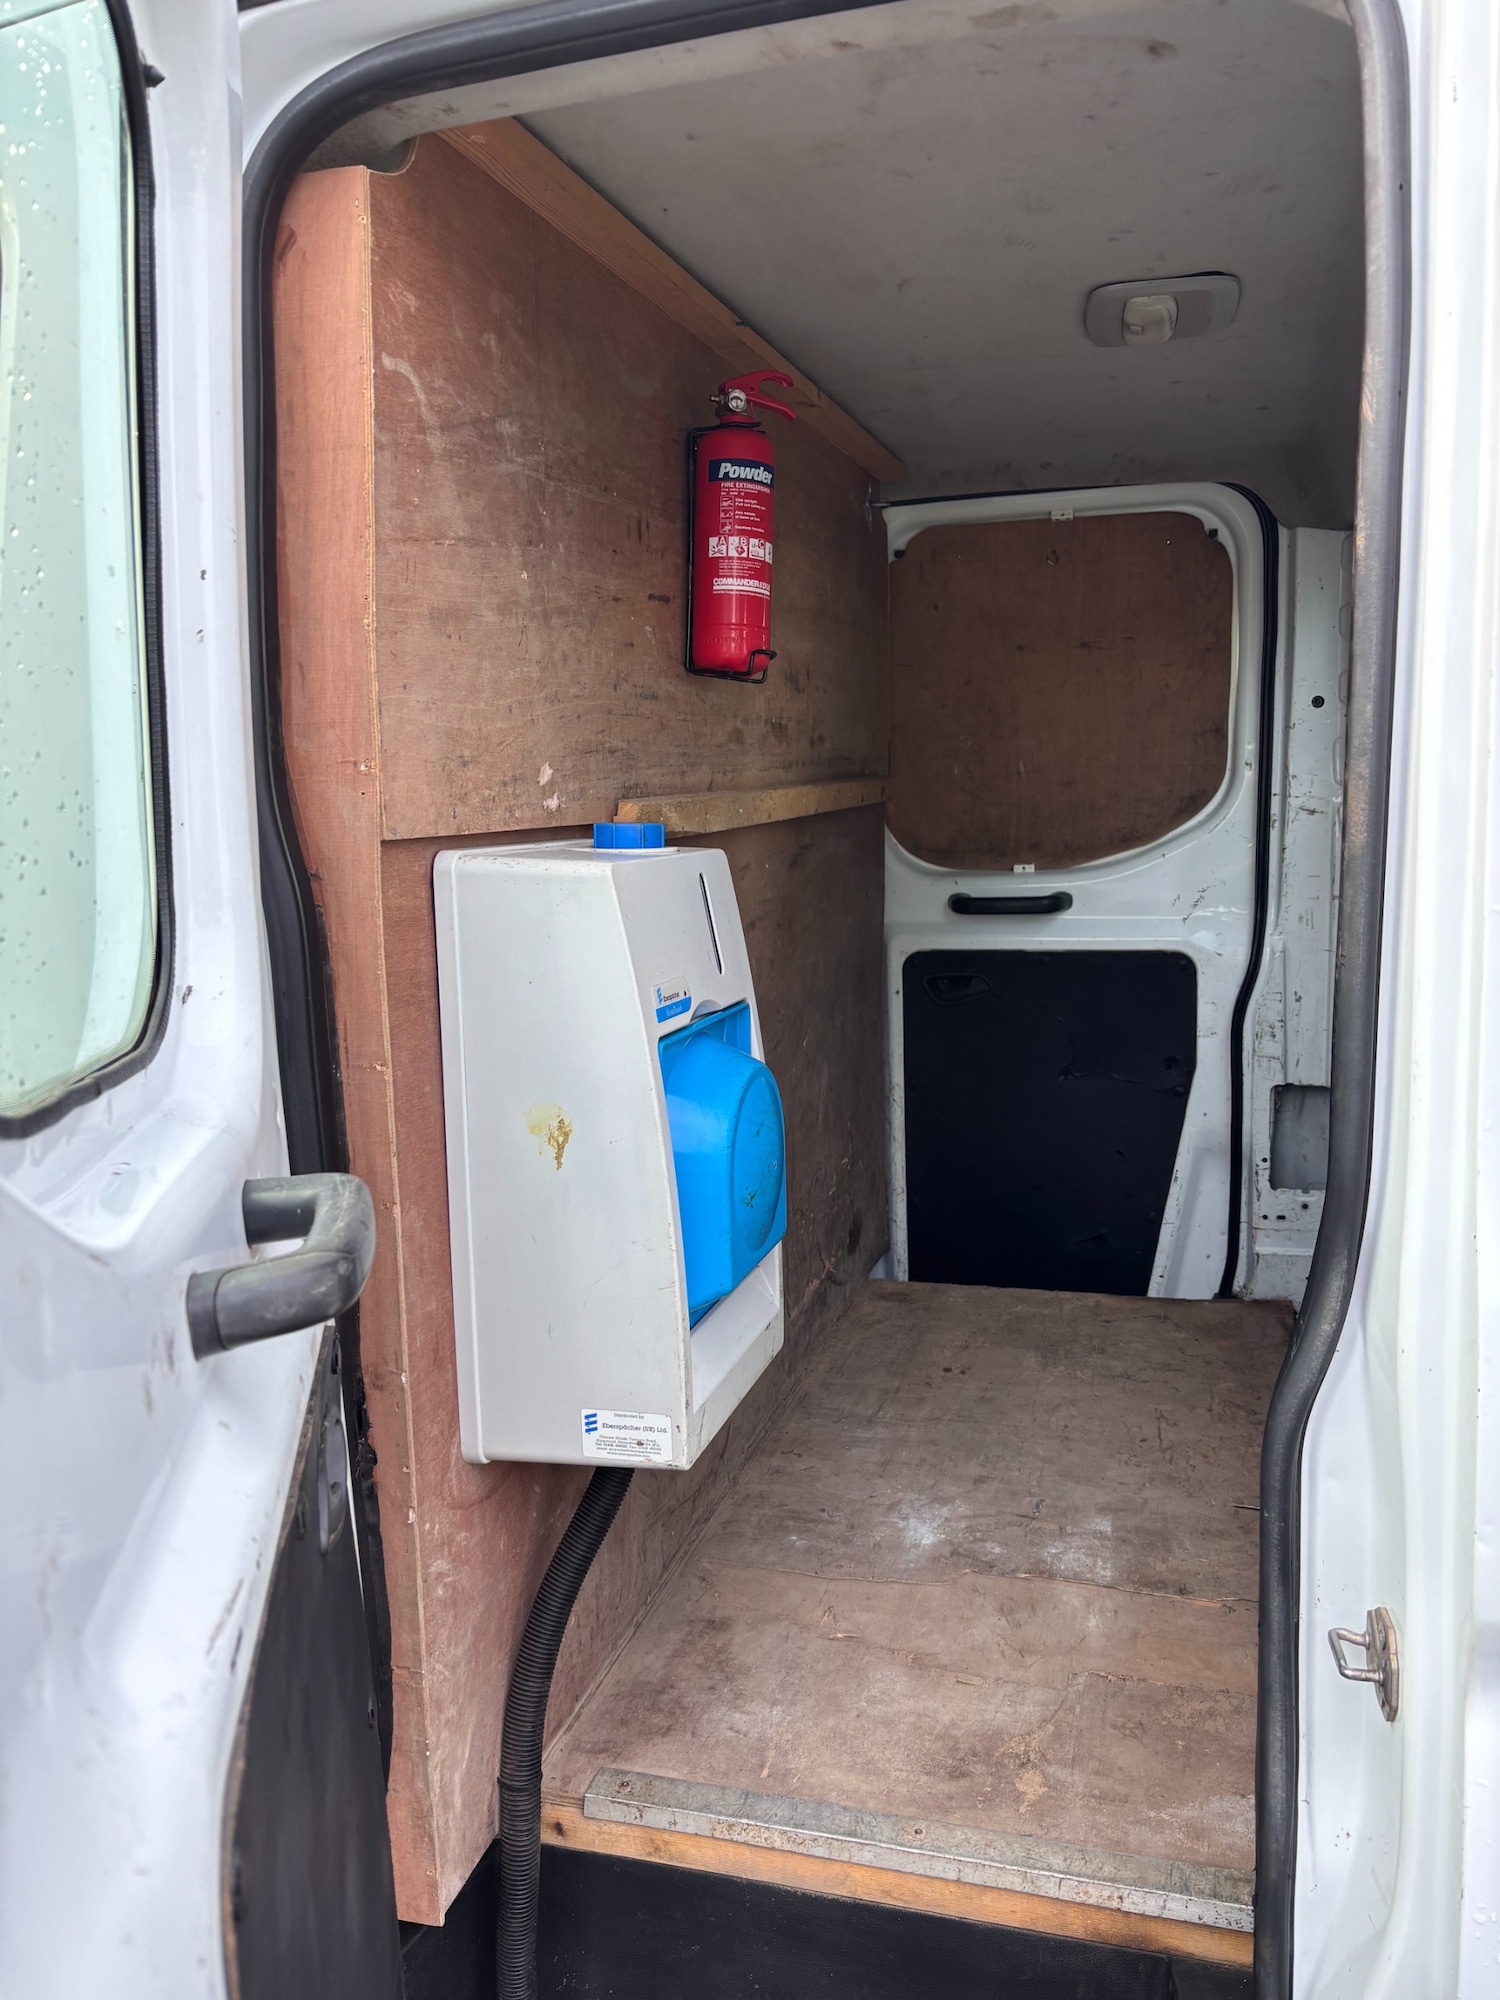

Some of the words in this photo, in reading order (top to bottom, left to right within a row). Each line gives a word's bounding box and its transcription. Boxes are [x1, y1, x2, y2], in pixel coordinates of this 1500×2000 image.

[718, 462, 773, 484] Powder
[719, 536, 726, 546] A
[740, 537, 747, 546] B
[759, 540, 765, 549] C
